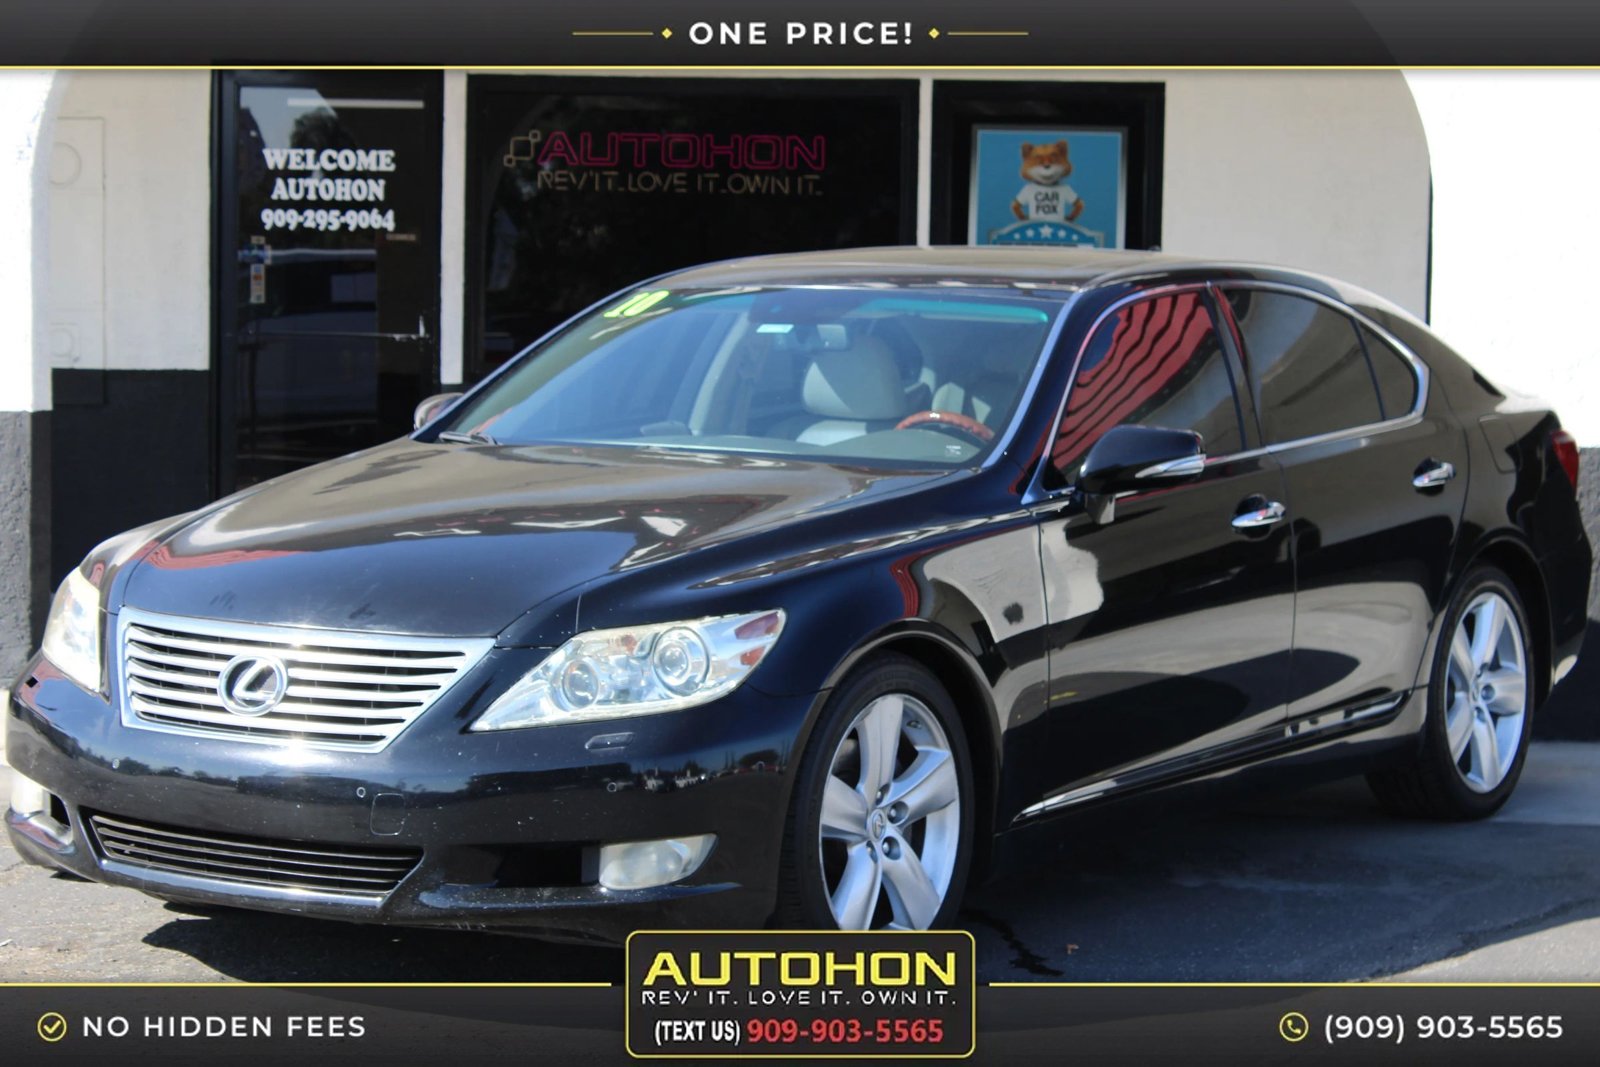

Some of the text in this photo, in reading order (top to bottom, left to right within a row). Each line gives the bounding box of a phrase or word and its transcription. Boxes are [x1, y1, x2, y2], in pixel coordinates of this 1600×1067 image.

[262, 148, 396, 172] WELCOME
[537, 130, 825, 170] AUTOHON
[271, 177, 386, 201] AUTOHON
[628, 171, 688, 193] LOVE
[728, 173, 789, 195] OWN
[1034, 191, 1060, 202] CAR
[261, 207, 396, 232] 909-295-9064
[1035, 203, 1059, 215] FOX
[603, 289, 670, 318] 10
